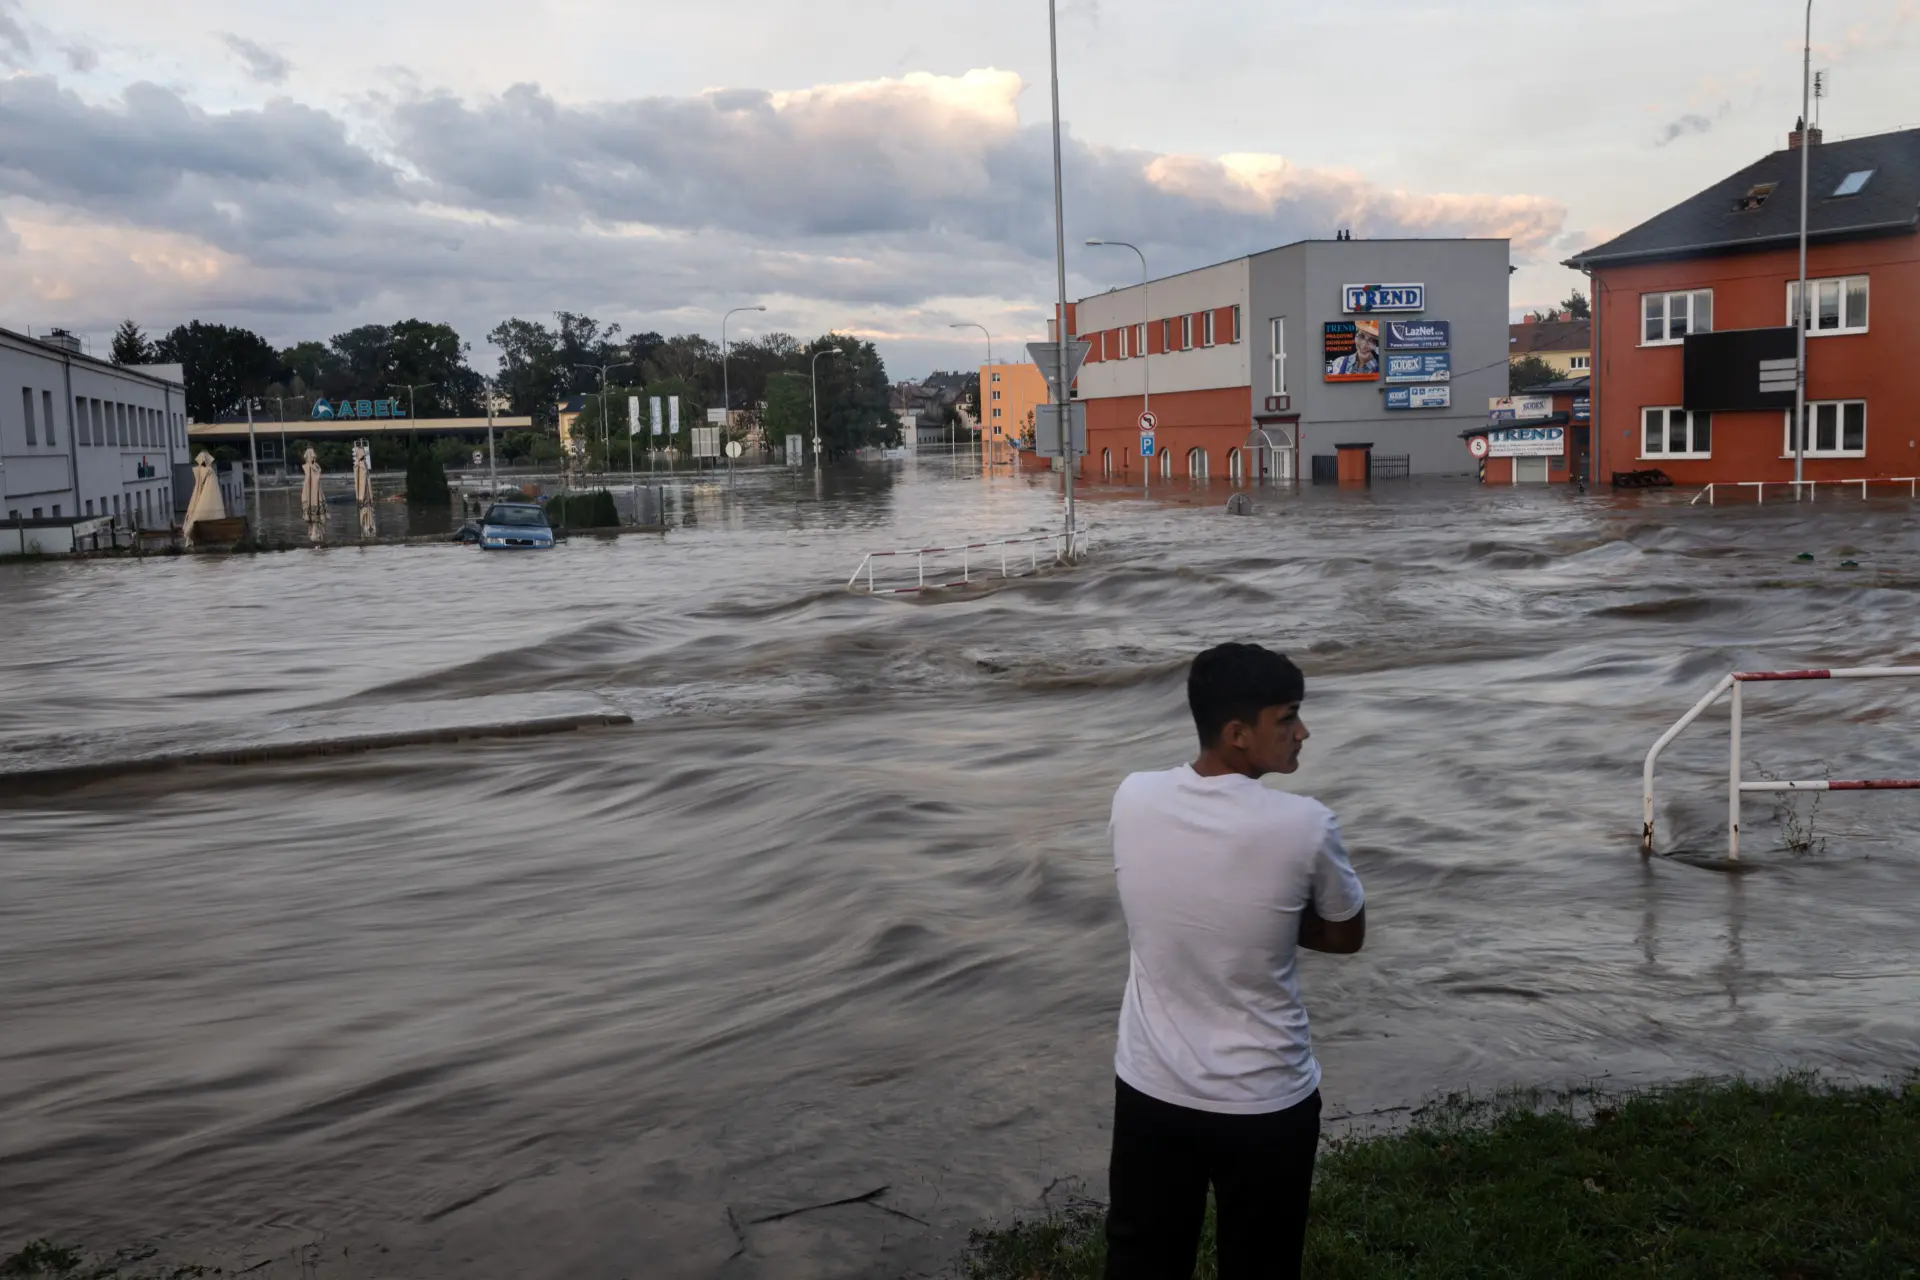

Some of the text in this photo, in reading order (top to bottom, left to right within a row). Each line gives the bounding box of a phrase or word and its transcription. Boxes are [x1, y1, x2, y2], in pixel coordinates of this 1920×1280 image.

[1352, 290, 1418, 305] TREND
[1325, 324, 1355, 333] TREND
[1405, 326, 1435, 336] LazNet
[1391, 358, 1419, 373] KODEX
[339, 399, 406, 418] ABEL
[1492, 428, 1563, 441] TREND
[1143, 439, 1152, 450] P
[1476, 442, 1482, 451] 5
